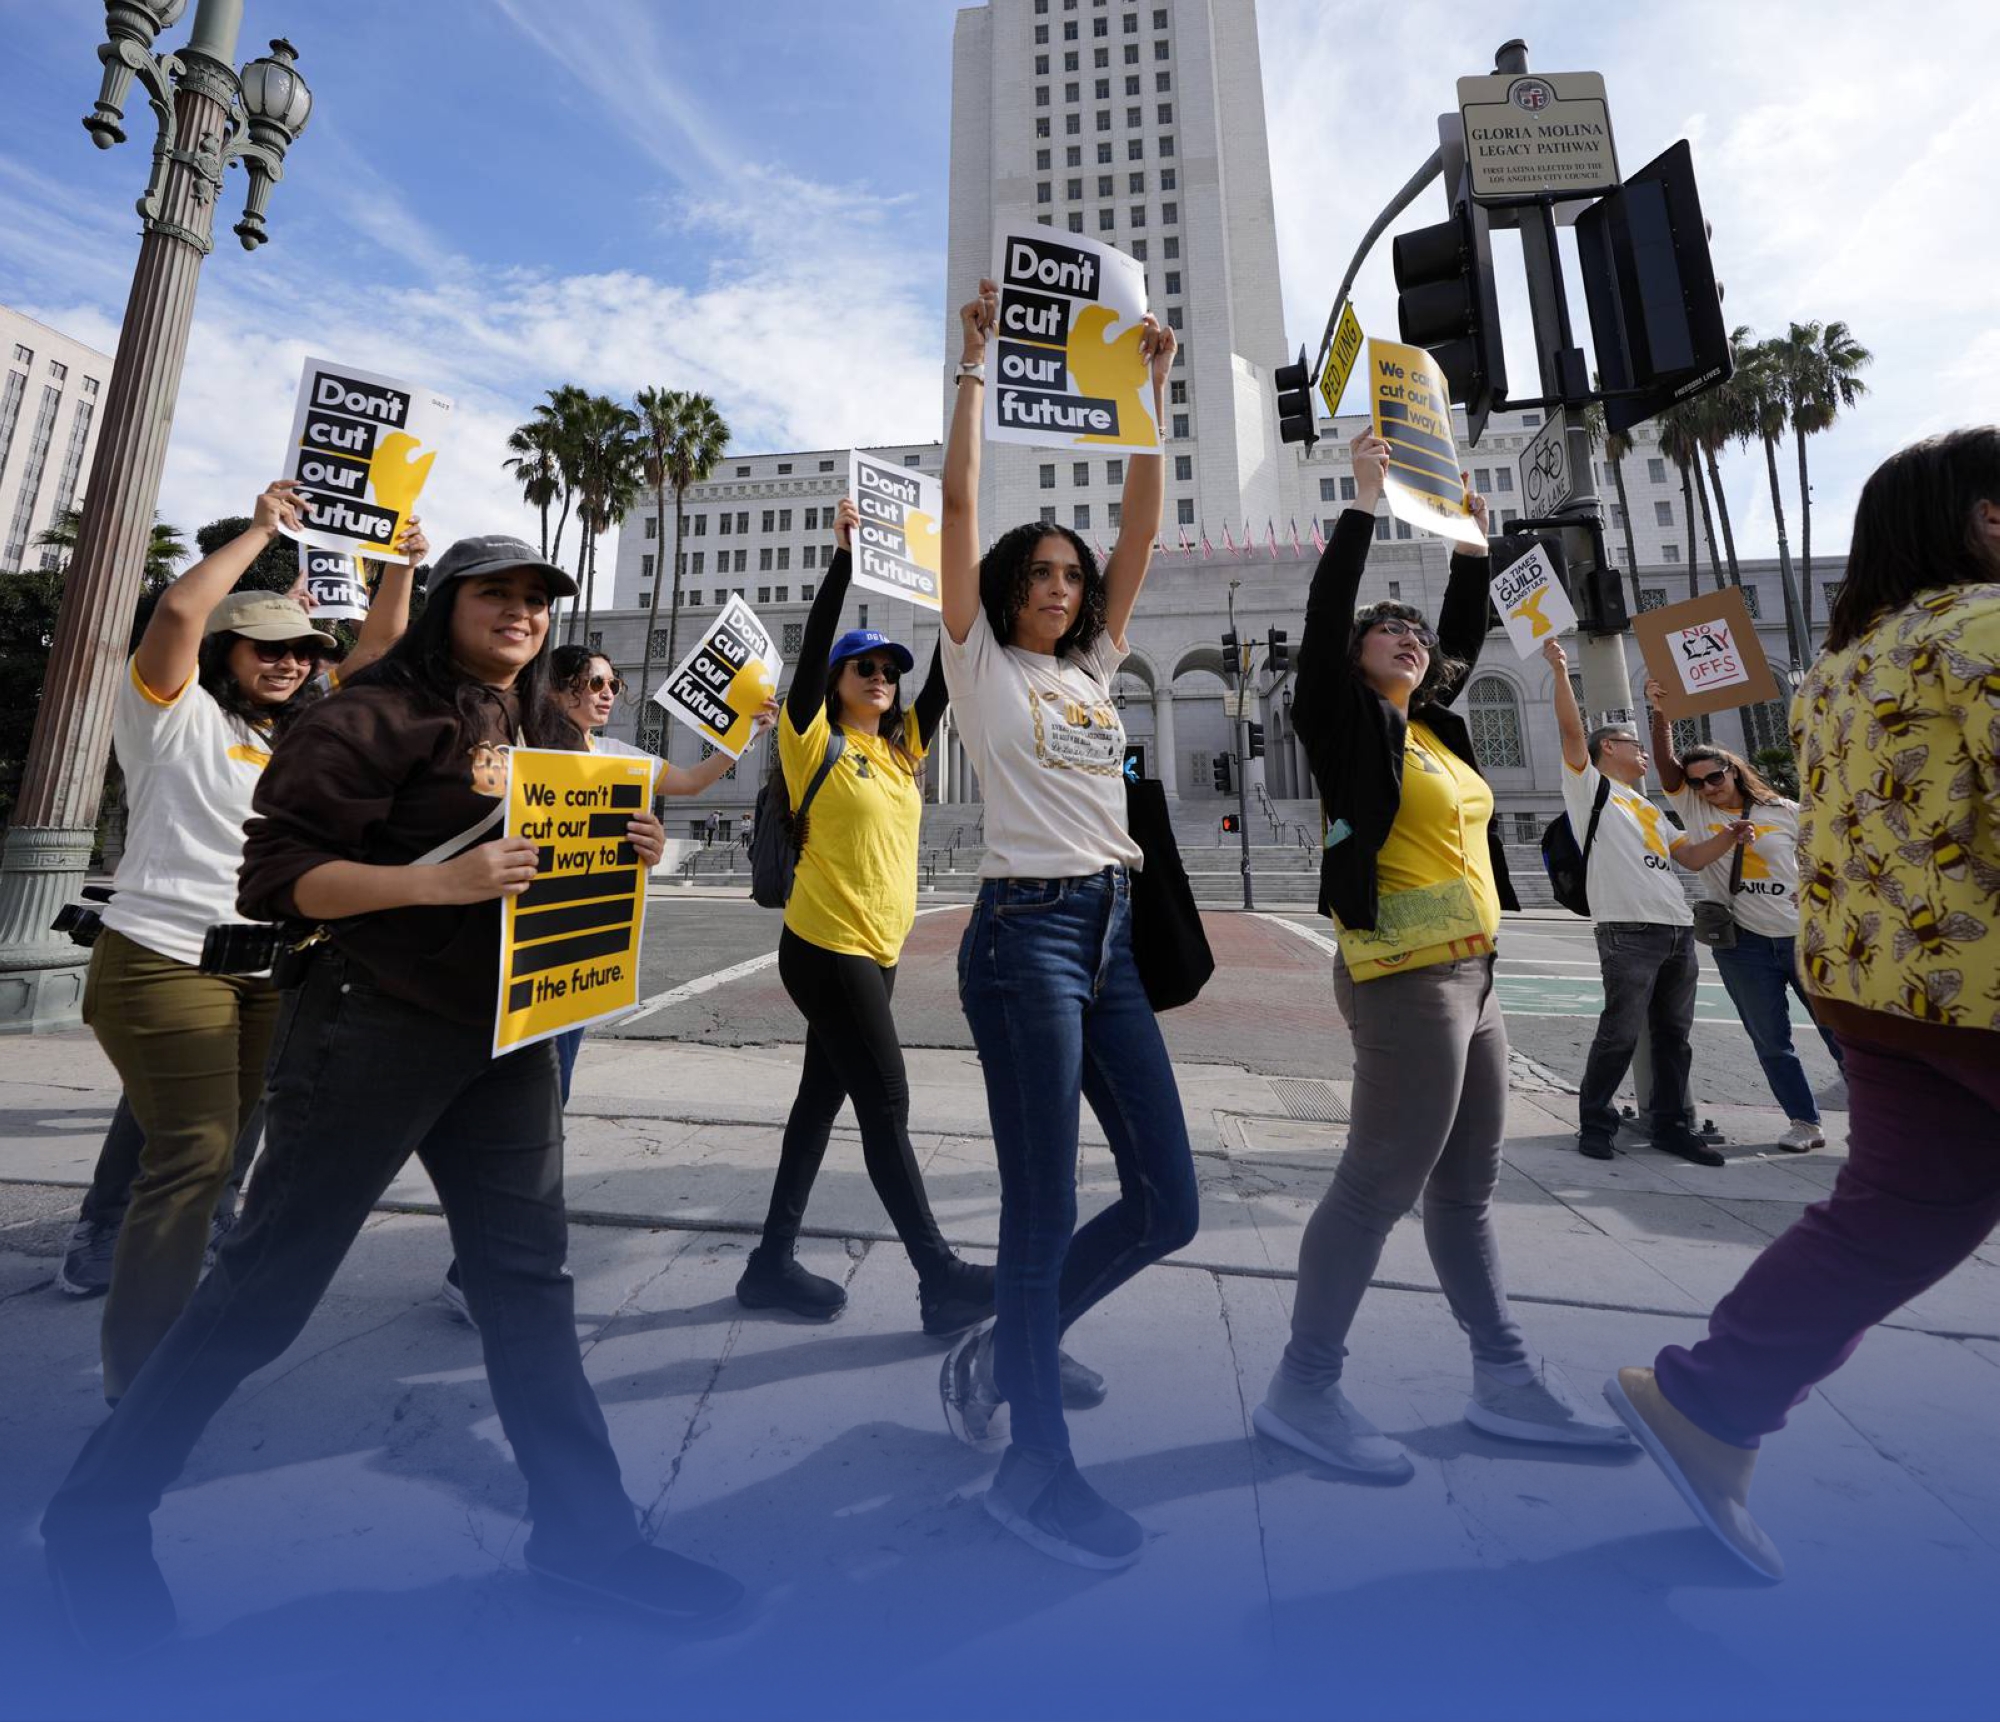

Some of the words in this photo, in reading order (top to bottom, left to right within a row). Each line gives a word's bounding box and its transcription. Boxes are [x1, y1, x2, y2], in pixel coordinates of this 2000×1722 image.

[1472, 128, 1532, 141] GLORIA
[1538, 124, 1603, 137] MOLINA
[1479, 144, 1531, 157] LEGACY
[1538, 141, 1600, 155] PATHWAY
[1483, 167, 1504, 175] FIRST
[1507, 165, 1535, 174] LATINA
[1537, 163, 1573, 172] ELECTED
[1587, 162, 1603, 170] THE
[1489, 176, 1505, 184] LOS
[1507, 174, 1542, 183] ANGELES
[1544, 173, 1562, 181] CITY
[1564, 172, 1600, 180] COUNCIL
[1010, 243, 1095, 292] Don't
[1004, 303, 1062, 337] cut
[1002, 354, 1061, 383] our
[1324, 364, 1341, 407] PED
[1336, 318, 1357, 372] XING
[1378, 360, 1405, 379] We
[316, 377, 404, 422] Don't
[1002, 391, 1112, 430] future
[1379, 384, 1405, 400] cut
[1407, 390, 1428, 408] our
[309, 422, 368, 451] cut
[1409, 411, 1436, 435] way
[302, 461, 365, 490] our
[861, 465, 916, 503] Don't
[1547, 477, 1566, 508] LANE
[861, 498, 899, 522] cut
[862, 527, 903, 550] our
[863, 549, 934, 592] future
[1494, 577, 1510, 591] L.A.
[1509, 553, 1537, 578] TIMES
[1500, 564, 1542, 602] GUILD
[1505, 585, 1531, 610] AGAINST
[728, 608, 767, 654] Don't
[1682, 625, 1710, 639] NO
[1683, 628, 1729, 661] LAY
[714, 634, 746, 663] cut
[695, 657, 730, 686] our
[1689, 655, 1736, 681] OFFS
[673, 675, 729, 728] future
[523, 784, 556, 807] We
[565, 784, 609, 807] can't
[520, 817, 553, 840] cut
[557, 820, 588, 840] our
[557, 851, 595, 876] way
[599, 845, 616, 866] to
[536, 979, 568, 1002] the
[571, 963, 625, 994] future.
